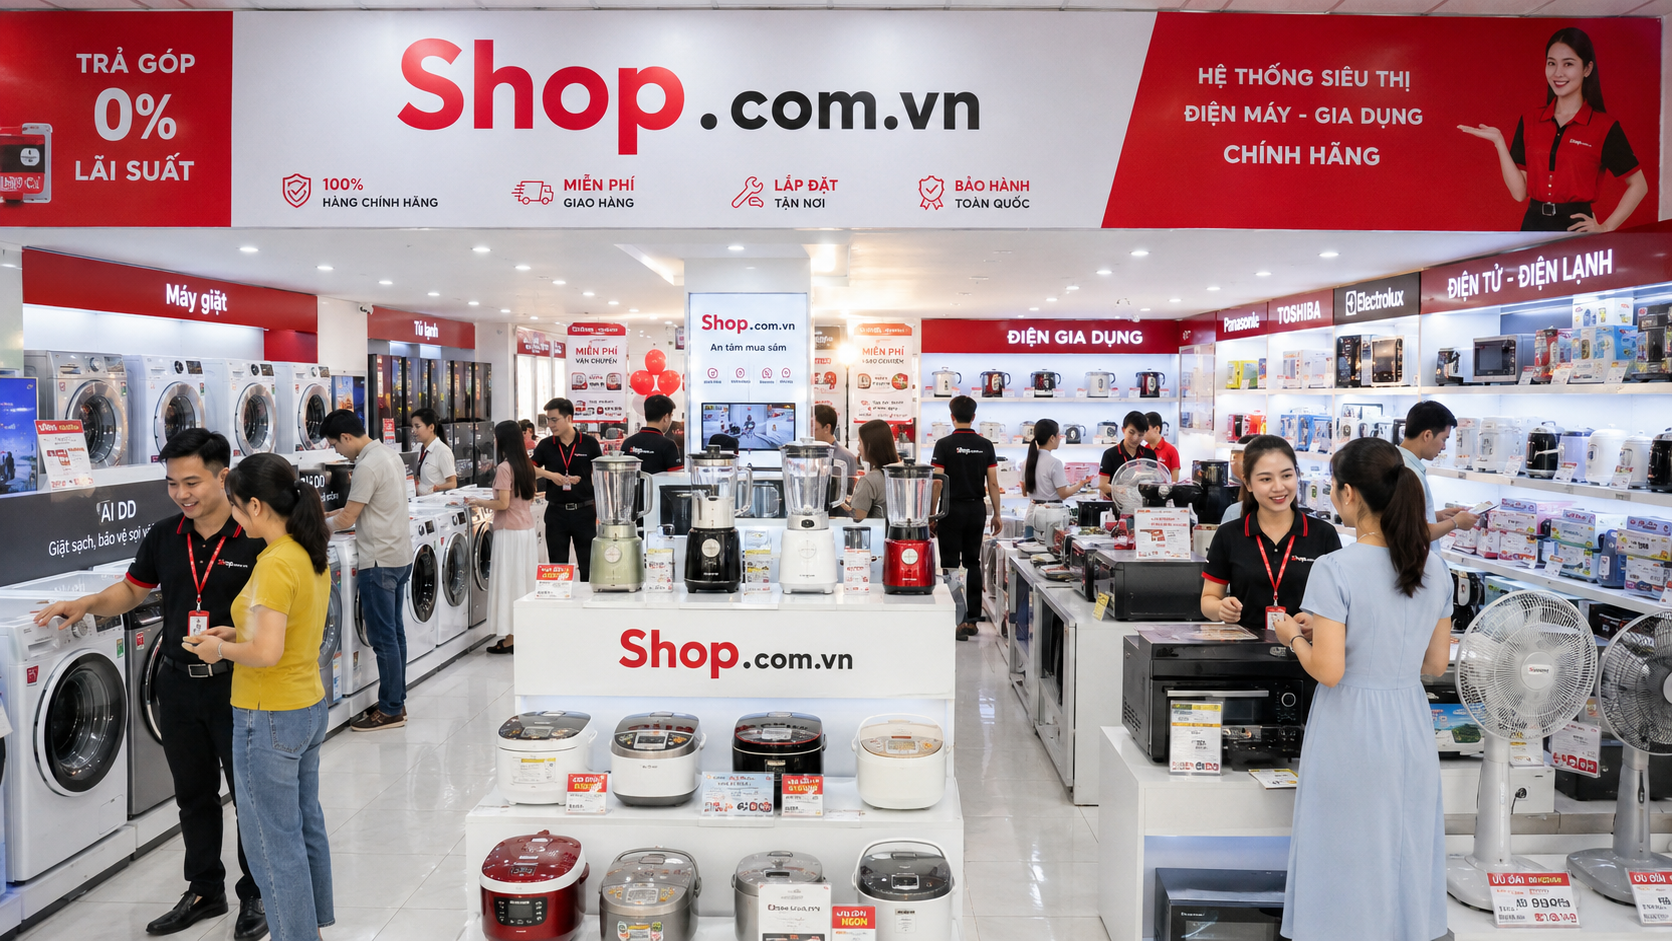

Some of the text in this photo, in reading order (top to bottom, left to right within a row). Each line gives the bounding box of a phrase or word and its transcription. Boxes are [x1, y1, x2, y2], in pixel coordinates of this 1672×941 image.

[76, 46, 196, 74] TRẢ GÓP
[1198, 62, 1411, 92] HỆ THỐNG SIÊU THỊ
[94, 87, 177, 141] 0%
[1184, 100, 1236, 127] ĐIỆN
[1244, 101, 1292, 123] MÁY
[1315, 106, 1353, 124] GIA
[1361, 107, 1423, 129] DỤNG
[1224, 140, 1380, 166] CHÍNH HÃNG
[75, 152, 195, 181] LÃI SUẤT
[322, 177, 364, 191] 100%
[563, 173, 636, 191] MIỄN PHÍ
[807, 176, 839, 194] ĐẶT
[955, 175, 1030, 192] BẢO HÀNH
[322, 195, 358, 208] HÀNG
[361, 195, 400, 208] CHÍNH
[563, 195, 635, 208] GIAO HÀNG
[774, 196, 799, 211] TẬN
[955, 194, 1030, 209] TOÀN QUỐC
[1447, 270, 1480, 302] ĐIỆN
[1482, 263, 1503, 293] TỬ
[1518, 255, 1558, 291] ĐIỆN
[1563, 248, 1613, 285] LẠNH
[166, 283, 228, 316] Máy giặt
[1357, 287, 1404, 313] Electrolux
[1277, 300, 1322, 325] TOSHIBA
[701, 314, 796, 334] Shop.com.vn
[710, 343, 723, 352] An
[1007, 326, 1144, 348] ĐIỆN GIA DỤNG
[101, 500, 137, 523] AI DD
[71, 534, 97, 554] sạch,
[841, 917, 868, 926] NGON
